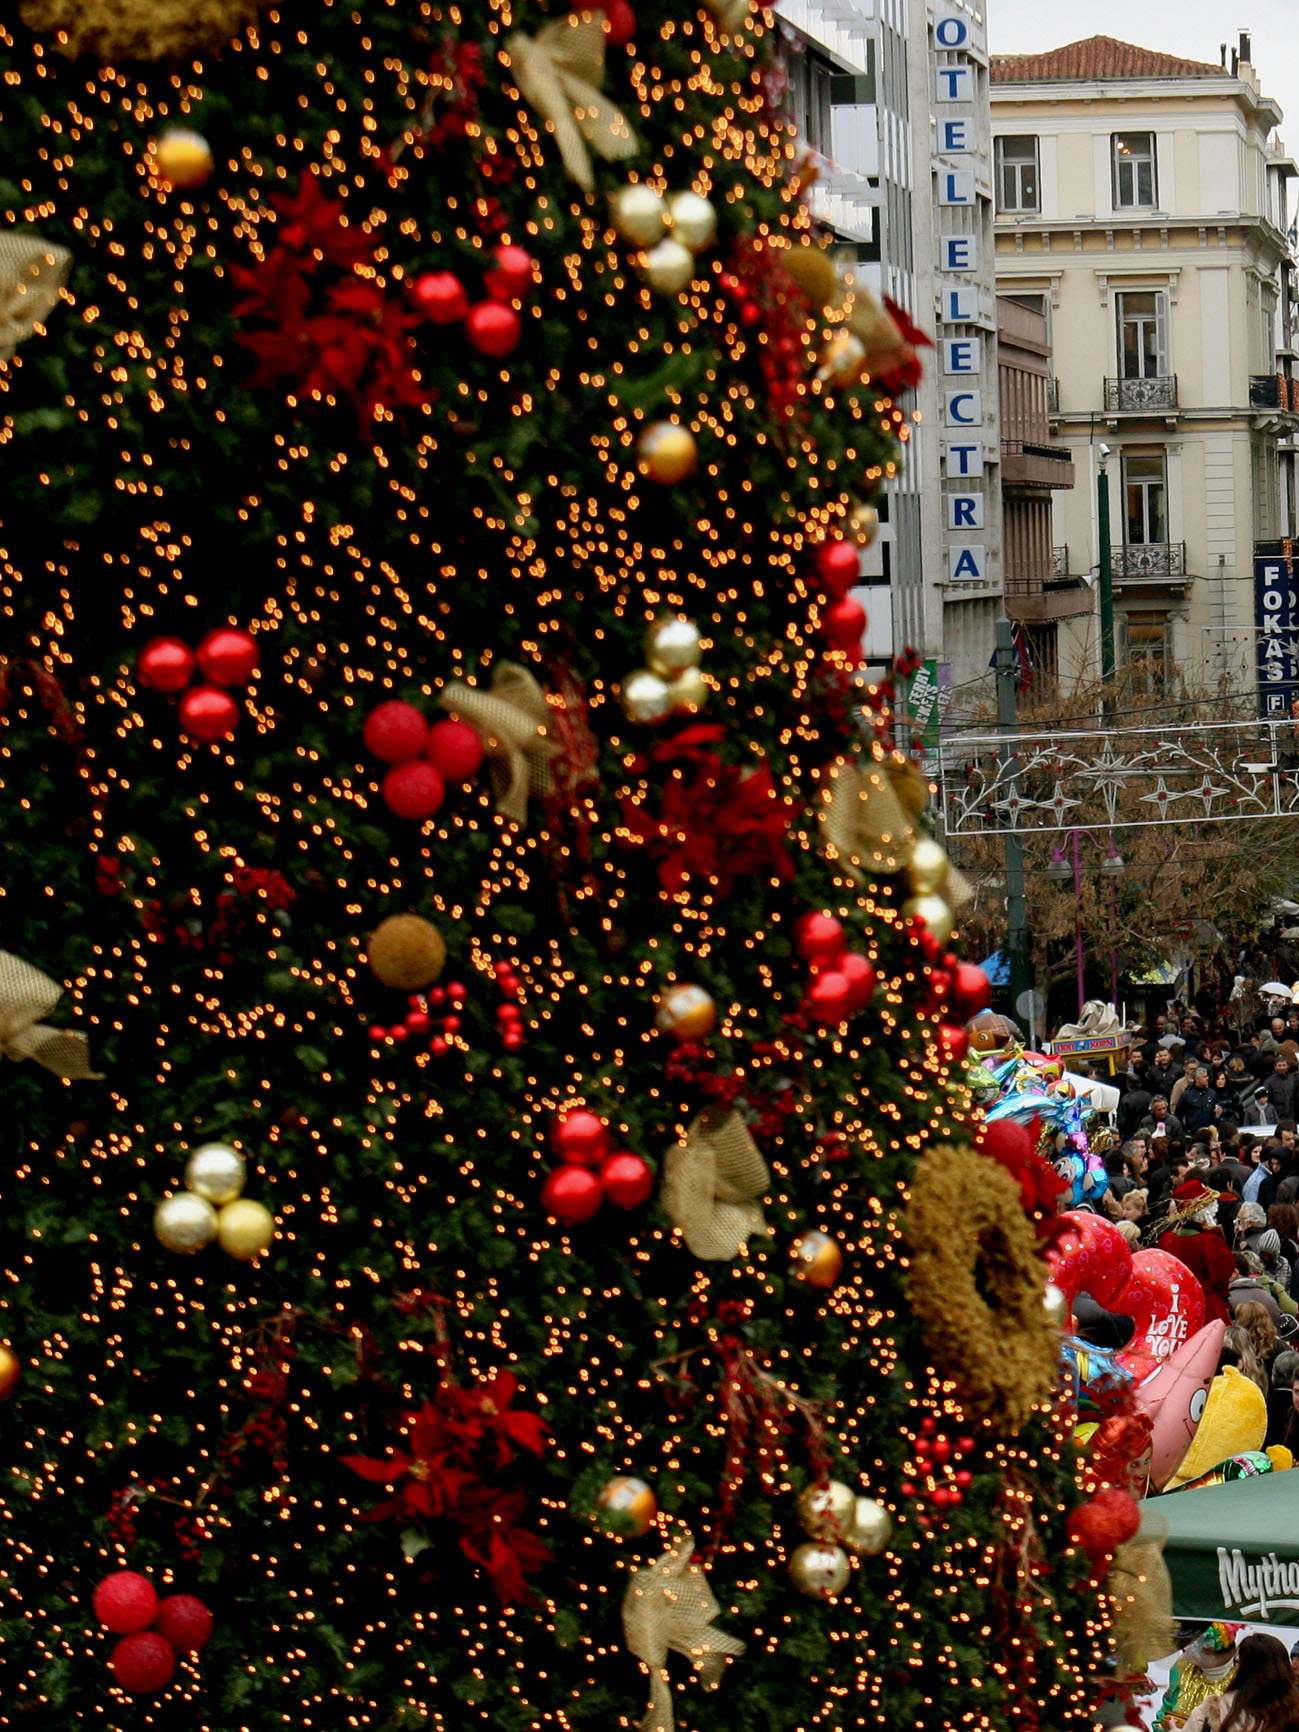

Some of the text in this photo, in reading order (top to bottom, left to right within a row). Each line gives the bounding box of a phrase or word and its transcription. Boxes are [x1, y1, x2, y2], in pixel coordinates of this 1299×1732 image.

[948, 240, 980, 578] ELECTRA
[1263, 566, 1284, 681] FOKAS
[1147, 1313, 1188, 1339] LOVE
